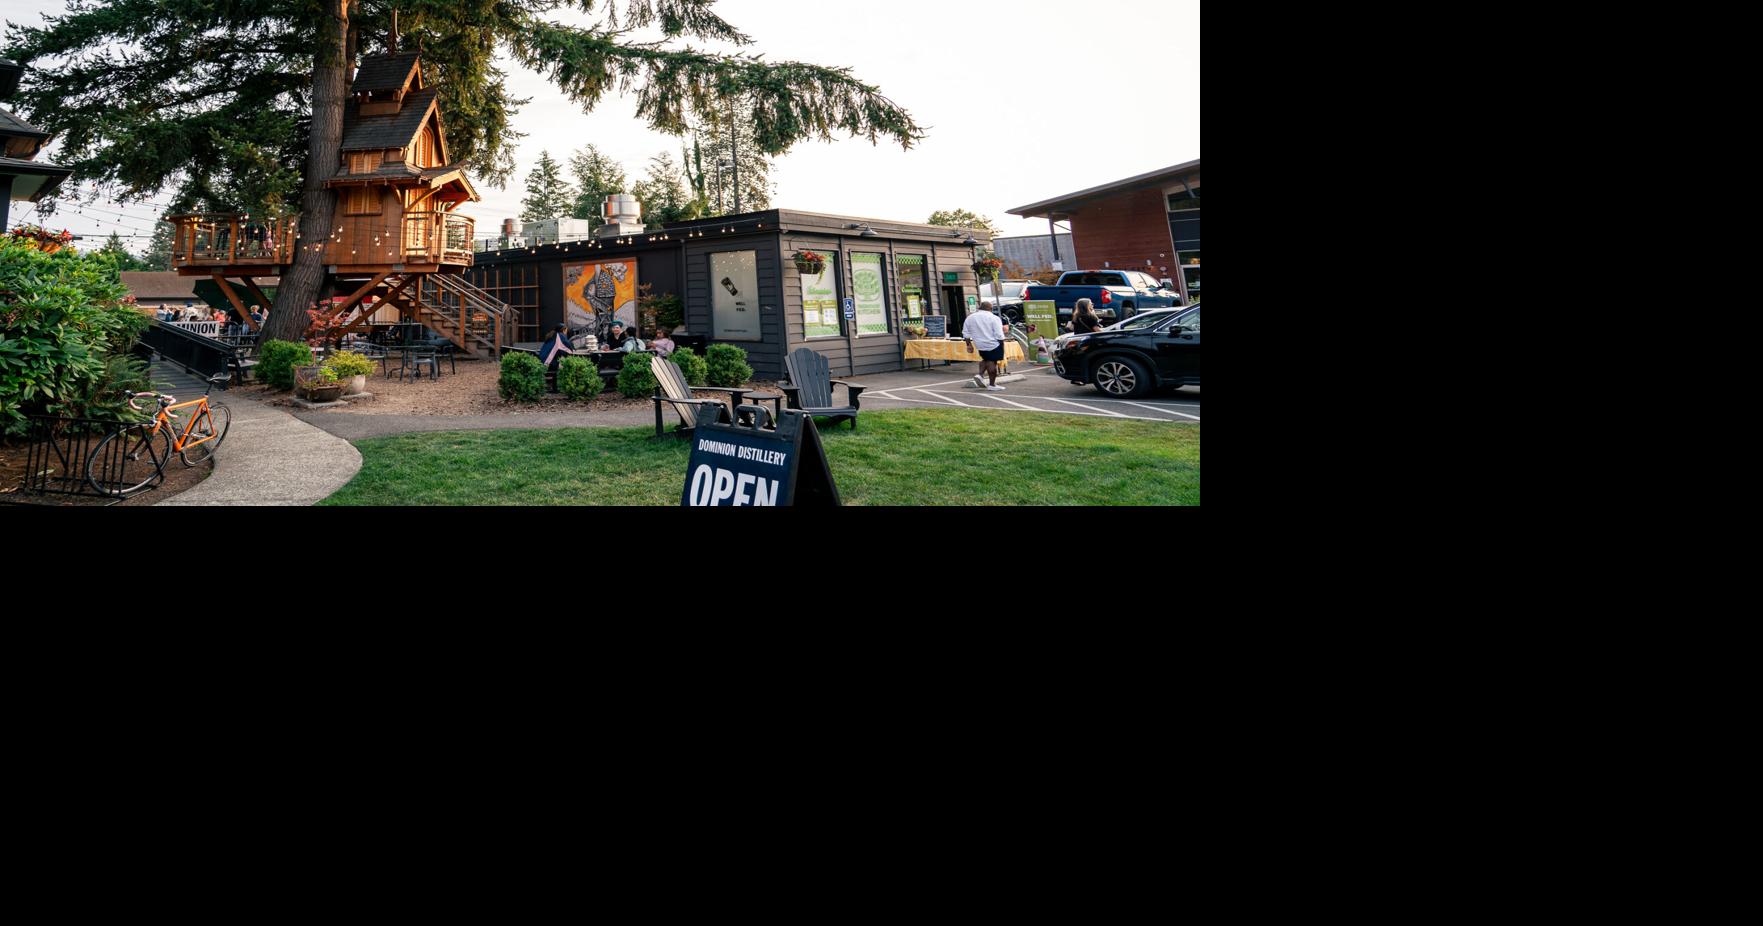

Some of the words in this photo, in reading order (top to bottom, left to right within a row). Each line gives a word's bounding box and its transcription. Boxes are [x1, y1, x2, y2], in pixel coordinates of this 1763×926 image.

[699, 439, 736, 456] DOMINION
[738, 446, 786, 465] DISTILLERY
[690, 464, 779, 506] OPEN
